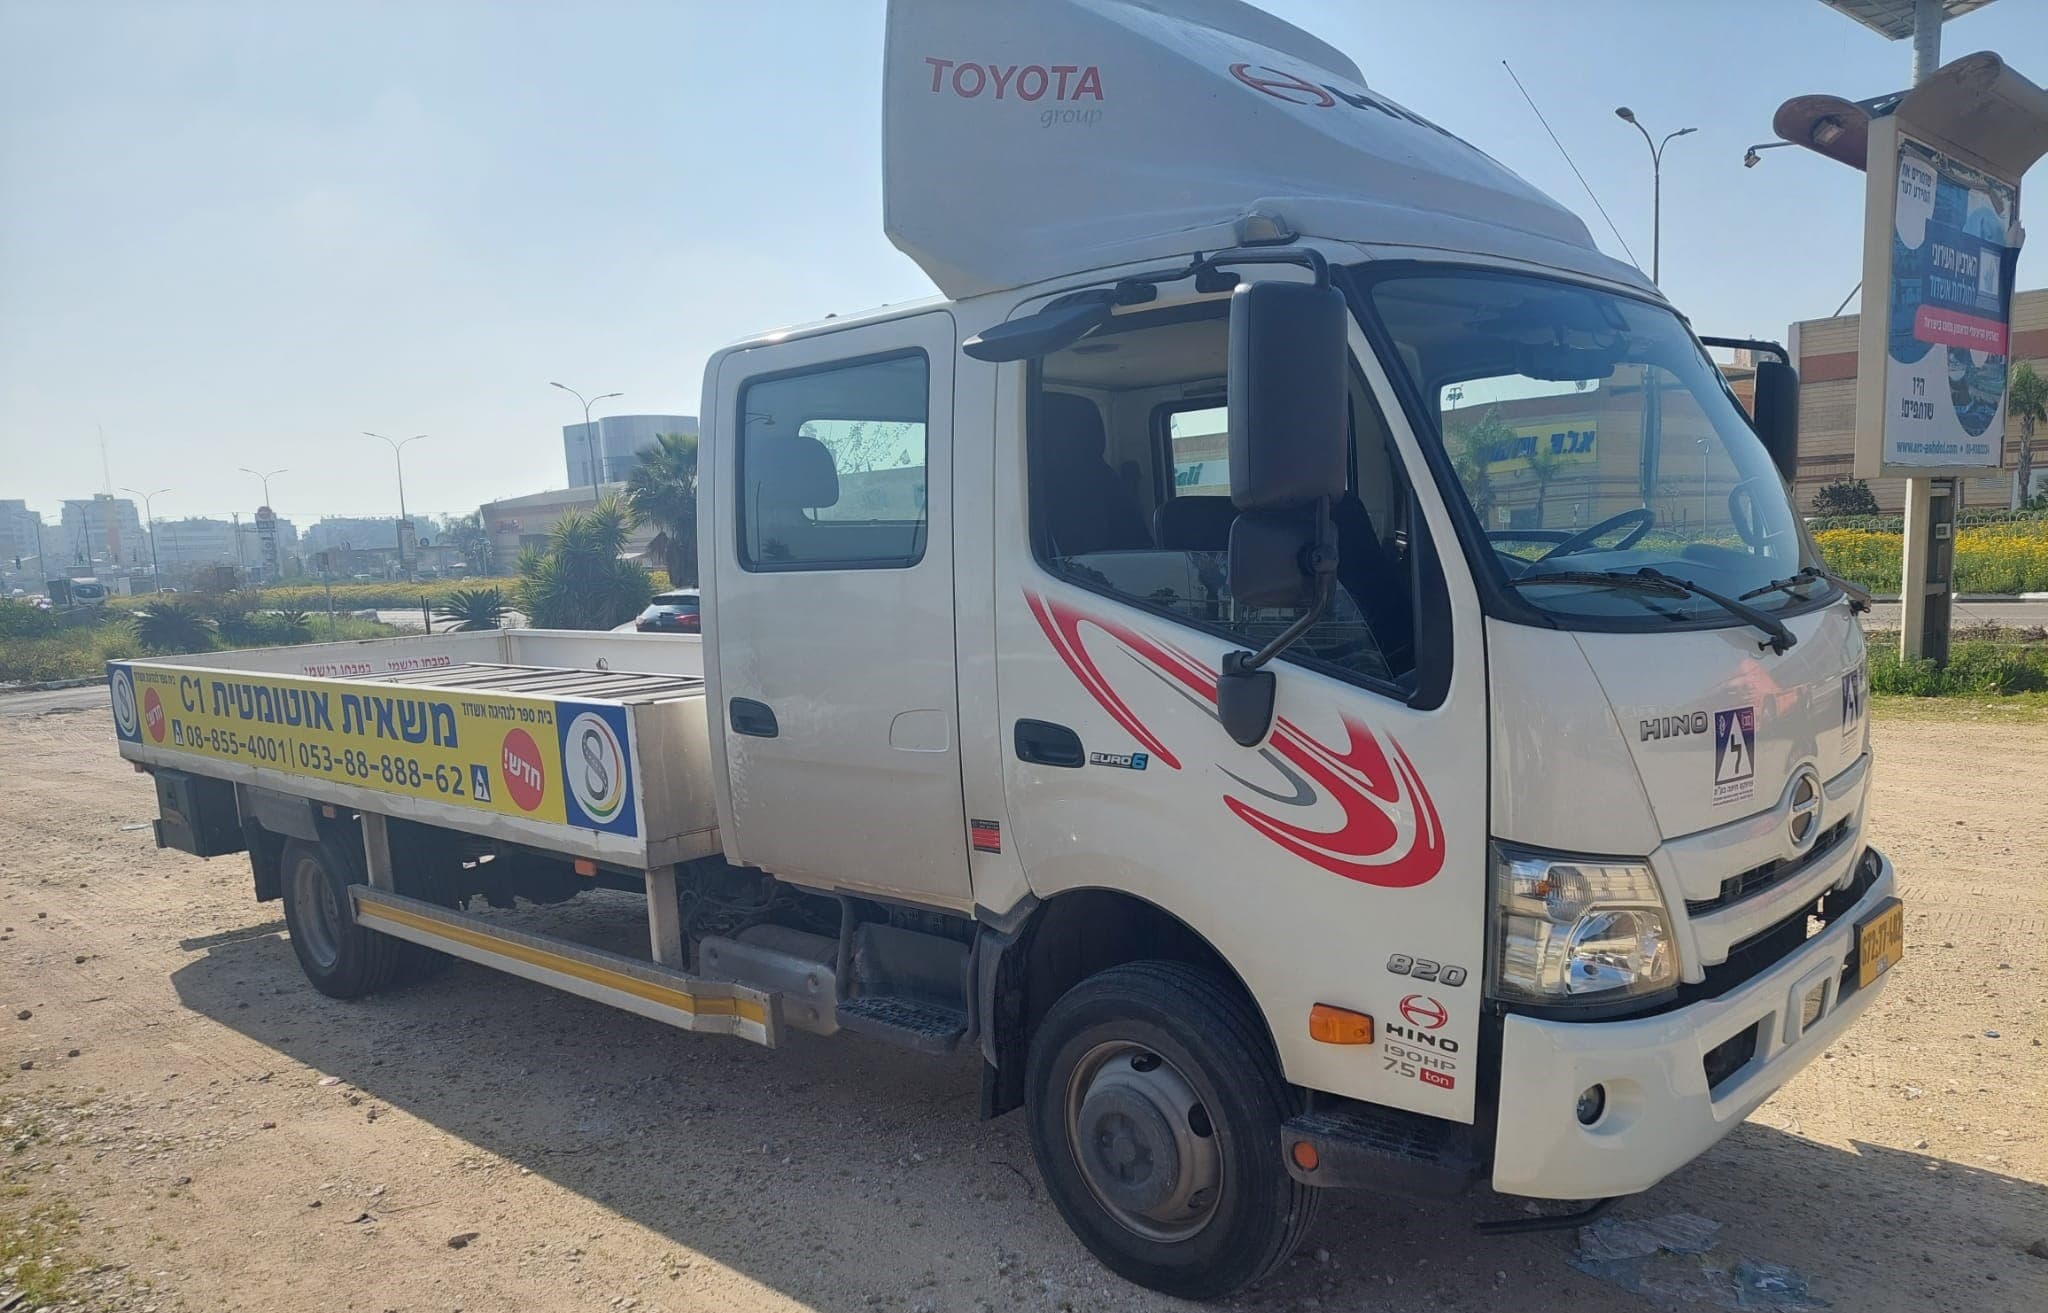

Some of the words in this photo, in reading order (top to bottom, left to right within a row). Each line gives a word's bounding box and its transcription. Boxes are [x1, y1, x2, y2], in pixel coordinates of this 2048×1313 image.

[925, 57, 1104, 101] TOYOTA
[1040, 107, 1103, 129] group
[1913, 376, 1925, 396] היו
[181, 675, 205, 713] C1
[212, 681, 334, 732] אוטומטית
[341, 693, 459, 749] משאית
[461, 702, 488, 719] אשדוד
[489, 703, 516, 721] לנהיגה
[517, 707, 535, 723] ספר
[538, 708, 553, 725] בית
[1640, 711, 1708, 742] HINO
[186, 725, 286, 763] 08-855-4001
[299, 742, 465, 796] 053-88-888-62
[504, 747, 541, 791] חדש!
[1386, 953, 1467, 987] 820
[1386, 1023, 1459, 1053] HINO
[1383, 1057, 1416, 1078] 7.5
[1425, 1070, 1449, 1086] ton
[1384, 1044, 1457, 1070] 190HP
